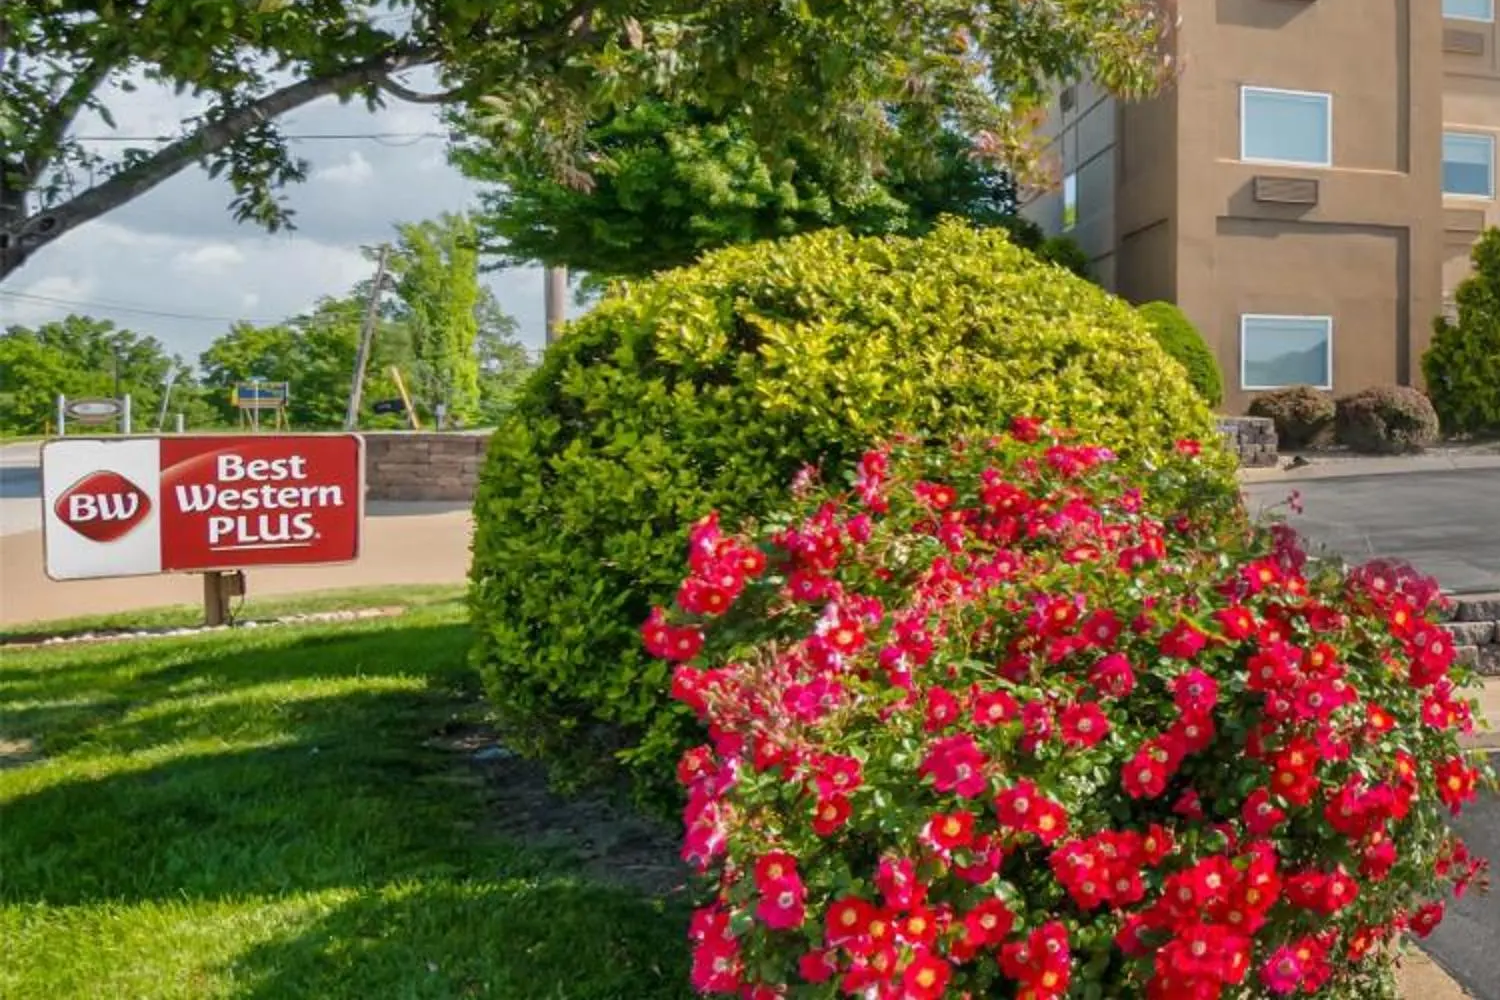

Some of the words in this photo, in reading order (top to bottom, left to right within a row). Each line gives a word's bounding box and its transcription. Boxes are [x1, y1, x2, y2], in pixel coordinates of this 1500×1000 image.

[217, 454, 308, 482] Best
[68, 492, 140, 522] BW
[175, 484, 344, 513] Western
[208, 513, 316, 544] PLUS
